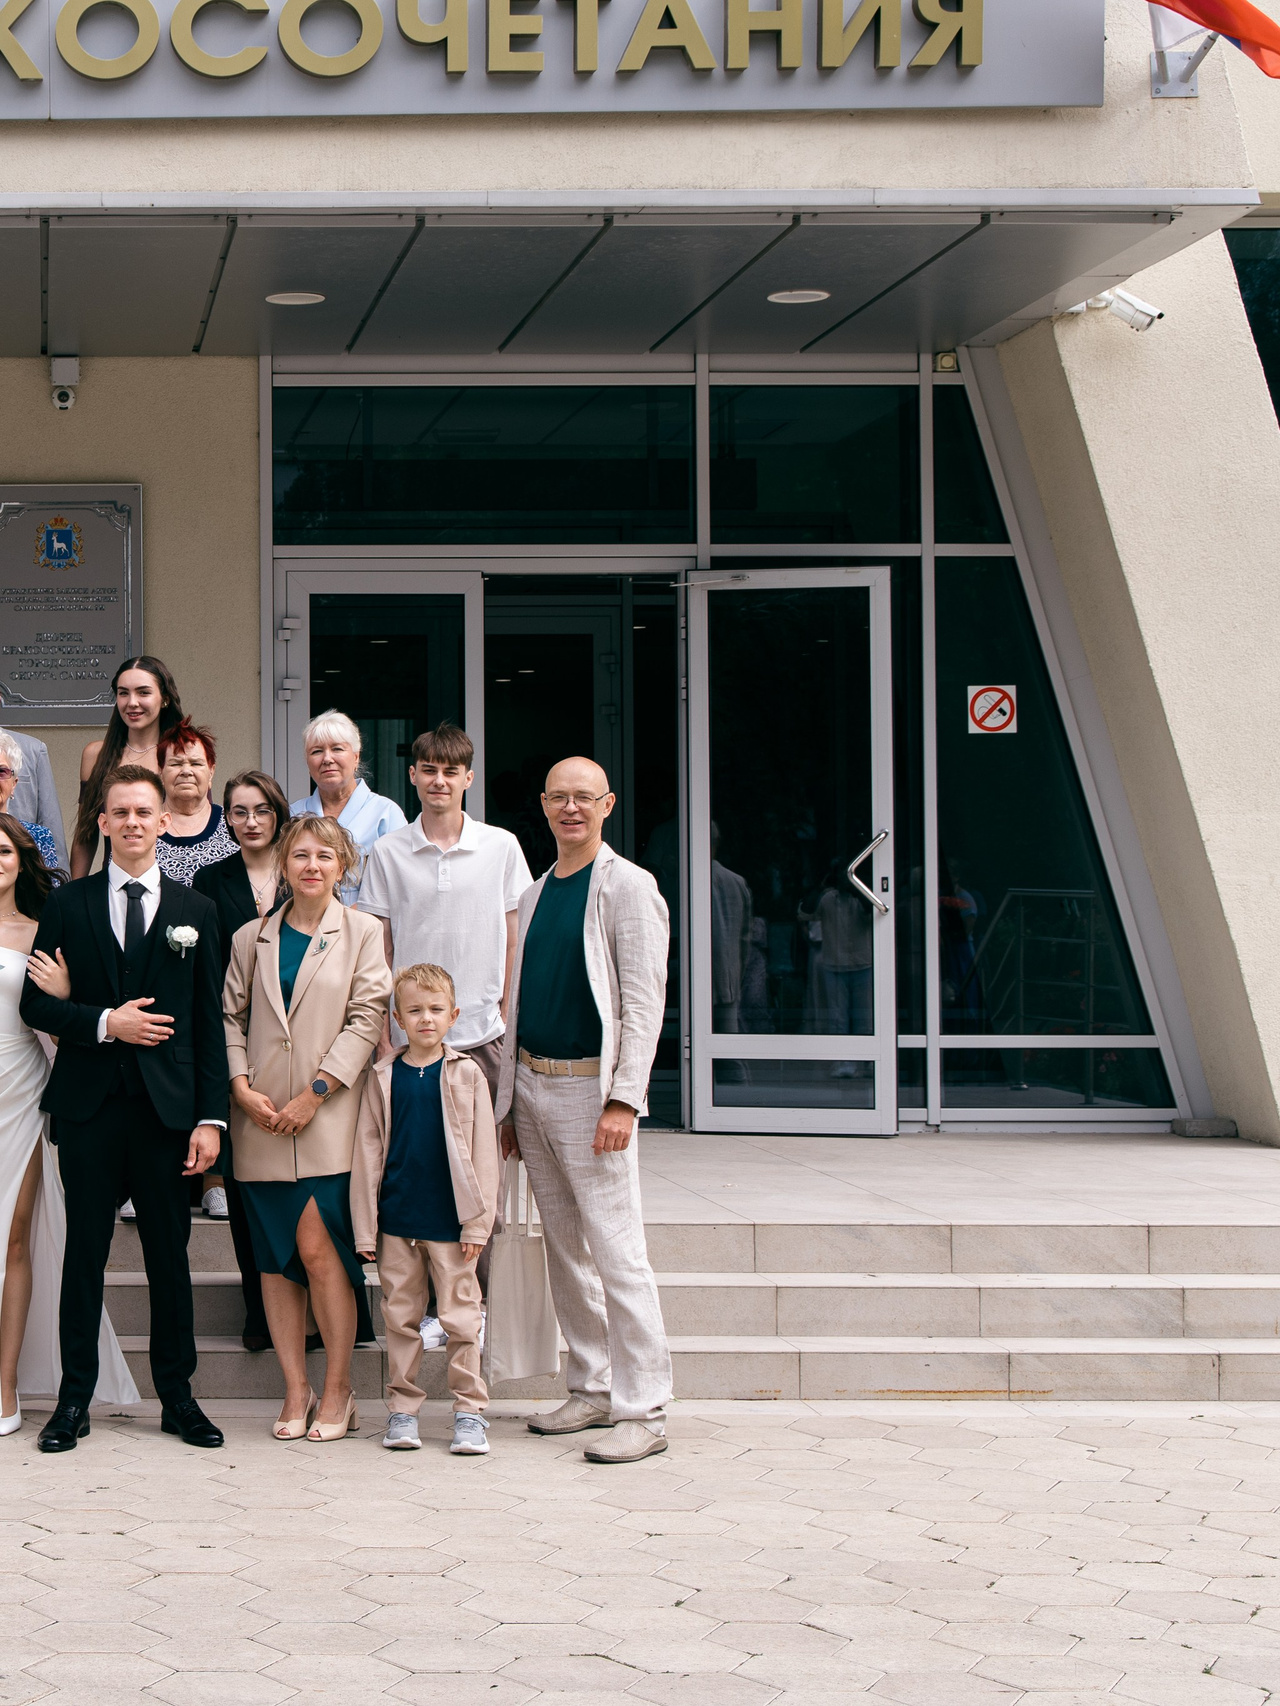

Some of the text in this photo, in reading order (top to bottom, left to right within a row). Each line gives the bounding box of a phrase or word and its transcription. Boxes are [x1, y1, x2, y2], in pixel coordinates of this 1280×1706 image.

[35, 632, 83, 643] ДВОРЕЦ
[1, 645, 116, 656] БРАКОСОЧЕТАНИЯ
[18, 658, 99, 669] ГОРОДСКОГО
[9, 671, 109, 681] ОКРУГА САМАРА
